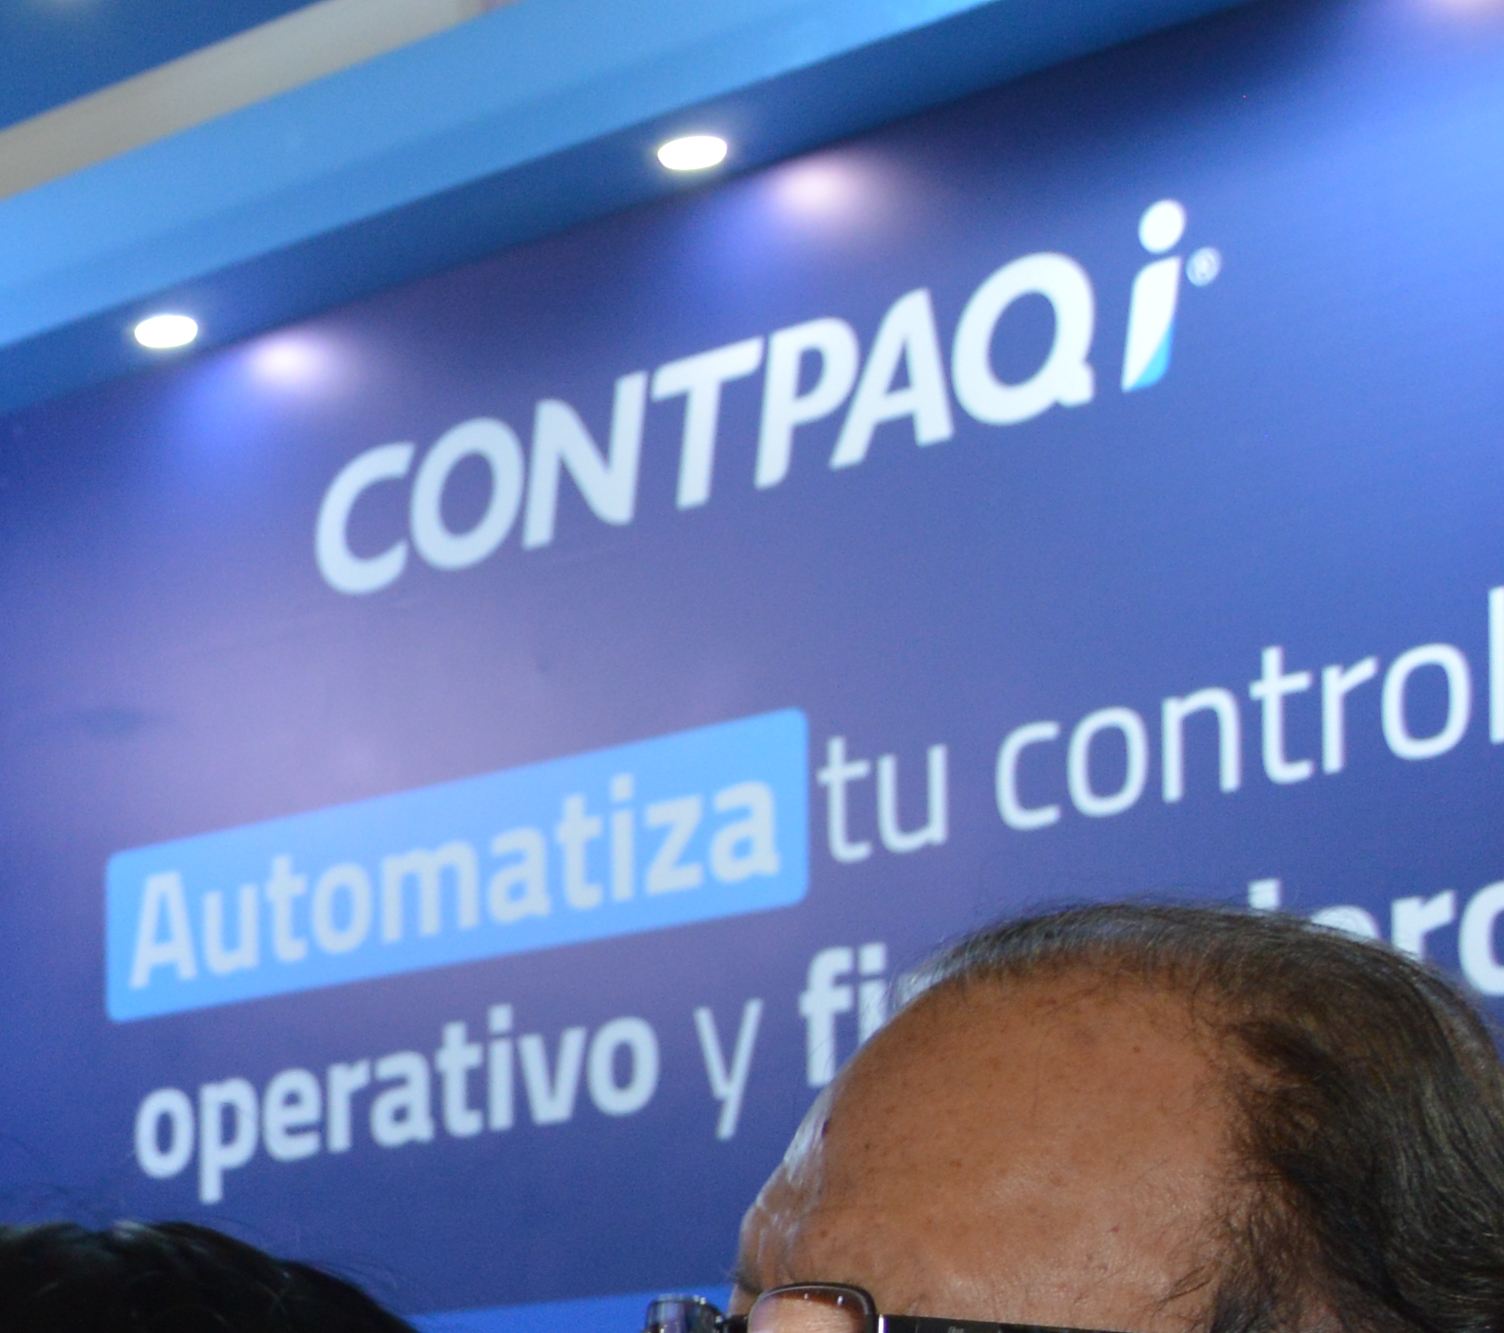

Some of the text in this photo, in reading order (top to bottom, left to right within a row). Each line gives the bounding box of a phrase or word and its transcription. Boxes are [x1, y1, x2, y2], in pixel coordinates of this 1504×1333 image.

[316, 201, 1190, 594] CONTPAQi
[128, 773, 779, 991] Automatiza
[817, 736, 947, 860] tu
[995, 586, 1504, 831] control
[136, 1000, 764, 1201] operativo y
